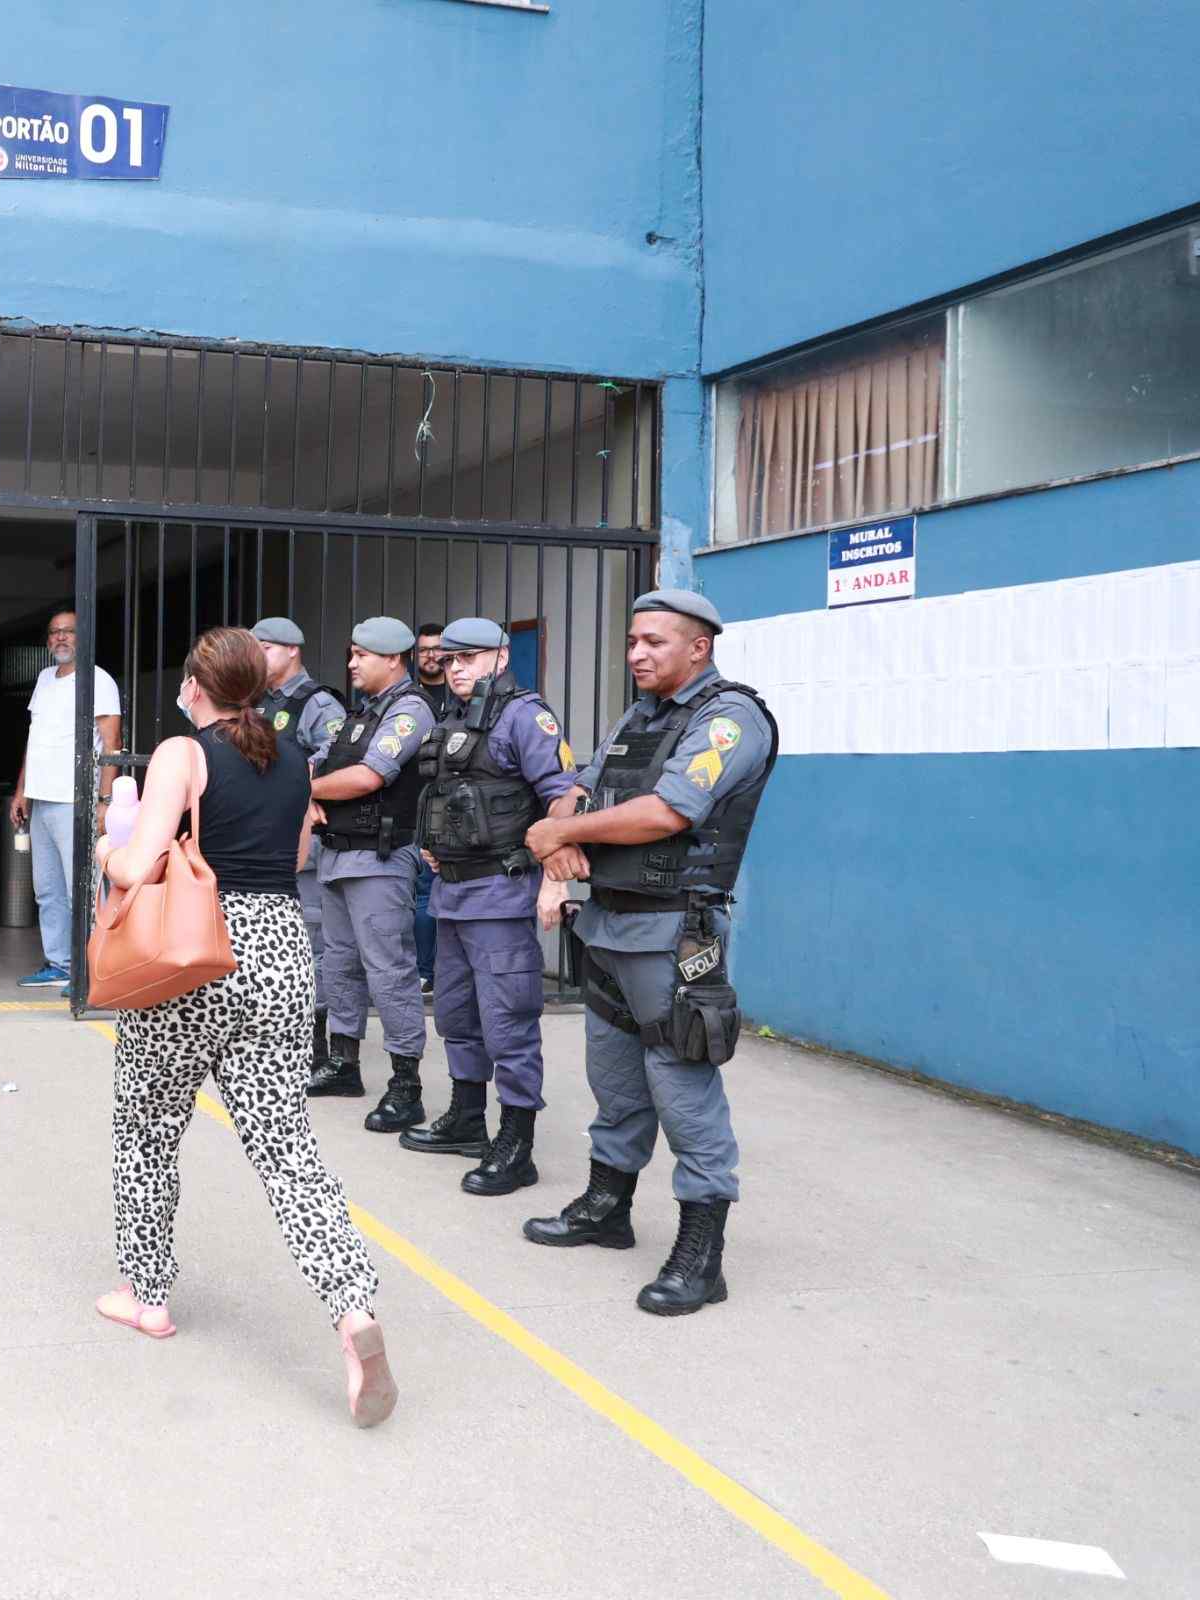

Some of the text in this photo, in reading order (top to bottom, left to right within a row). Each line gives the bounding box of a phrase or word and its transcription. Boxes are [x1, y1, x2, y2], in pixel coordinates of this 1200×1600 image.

[79, 104, 143, 168] 01
[15, 153, 68, 166] UNIVERSIDADE
[15, 160, 68, 174] Nilton Lins
[849, 526, 893, 545] MURAL
[841, 541, 903, 562] INSCRITOS
[852, 569, 910, 591] ANDAR
